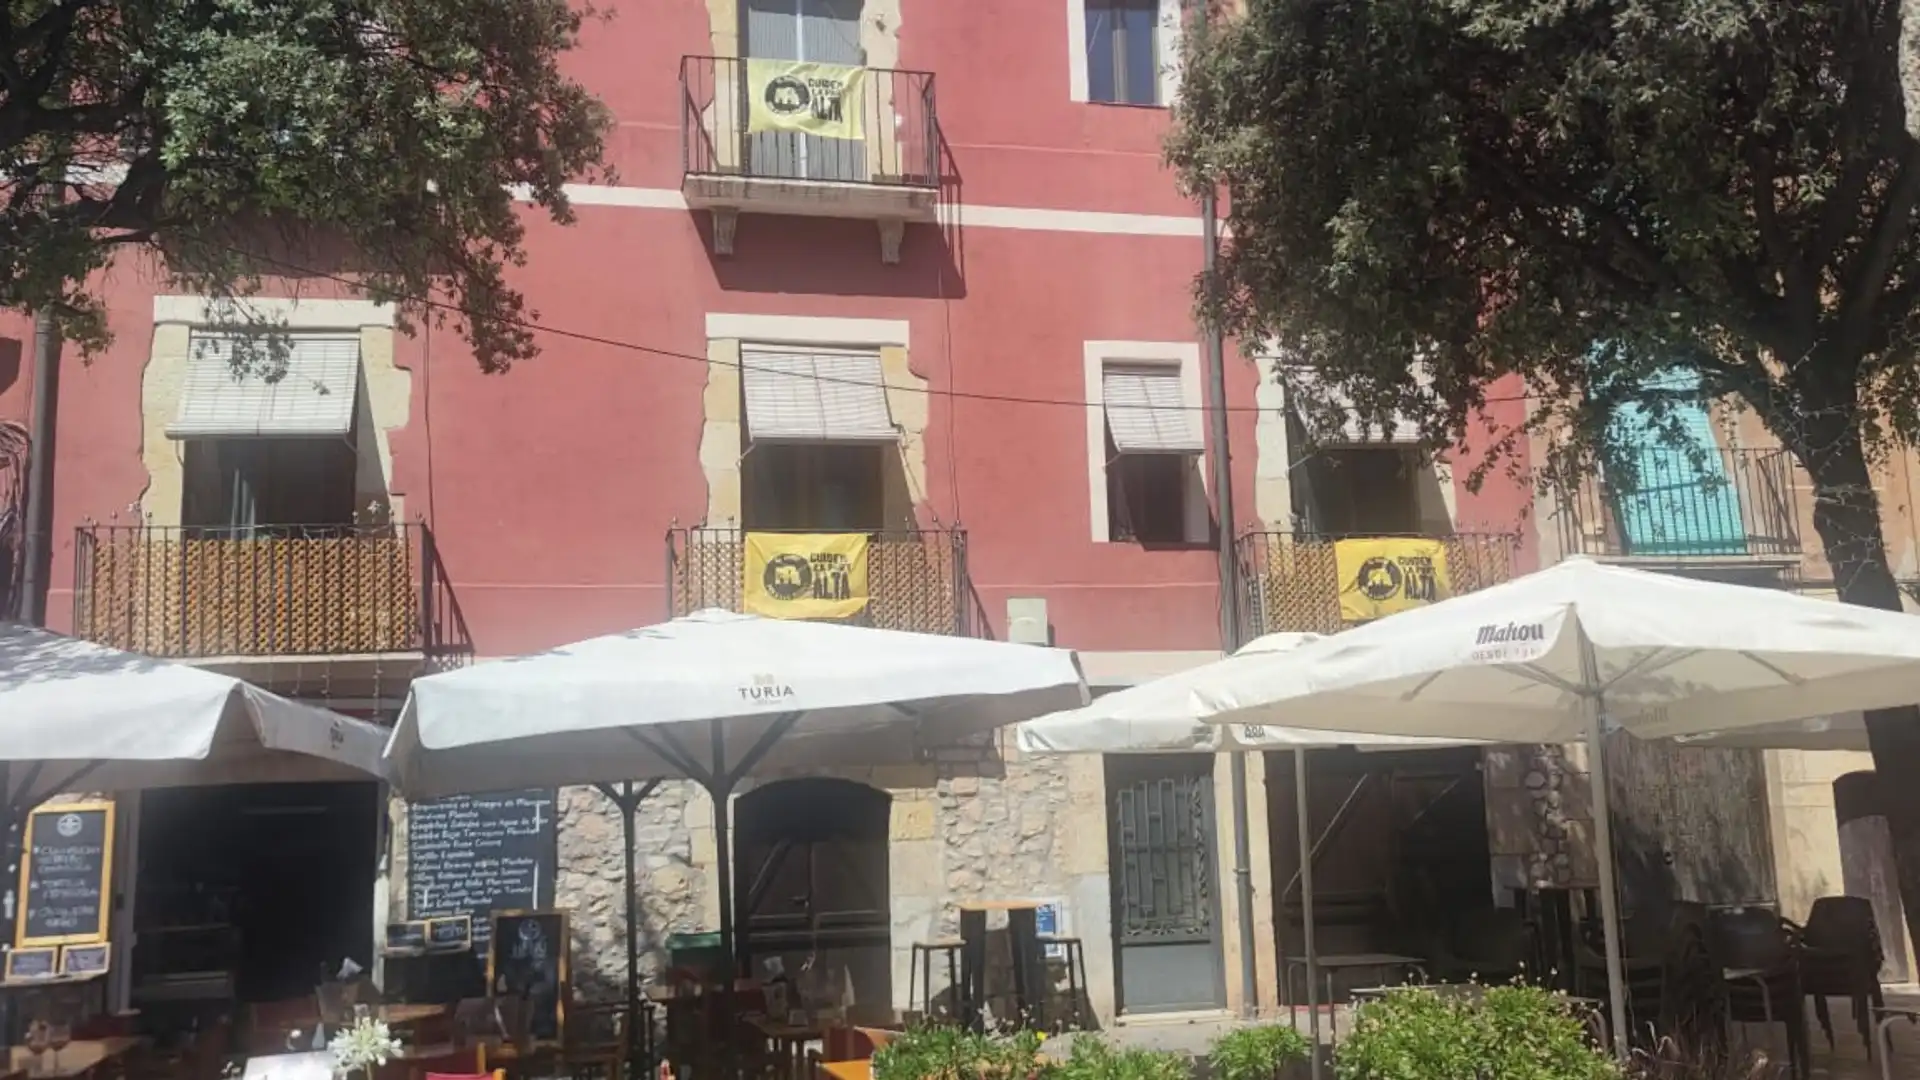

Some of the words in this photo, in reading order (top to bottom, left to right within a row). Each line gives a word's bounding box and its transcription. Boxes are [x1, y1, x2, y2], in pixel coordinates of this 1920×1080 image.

[811, 96, 843, 124] ALTA
[813, 572, 851, 600] ALTA
[1404, 575, 1437, 602] ALTA
[1475, 620, 1544, 645] Mahou
[737, 684, 795, 701] TURIA
